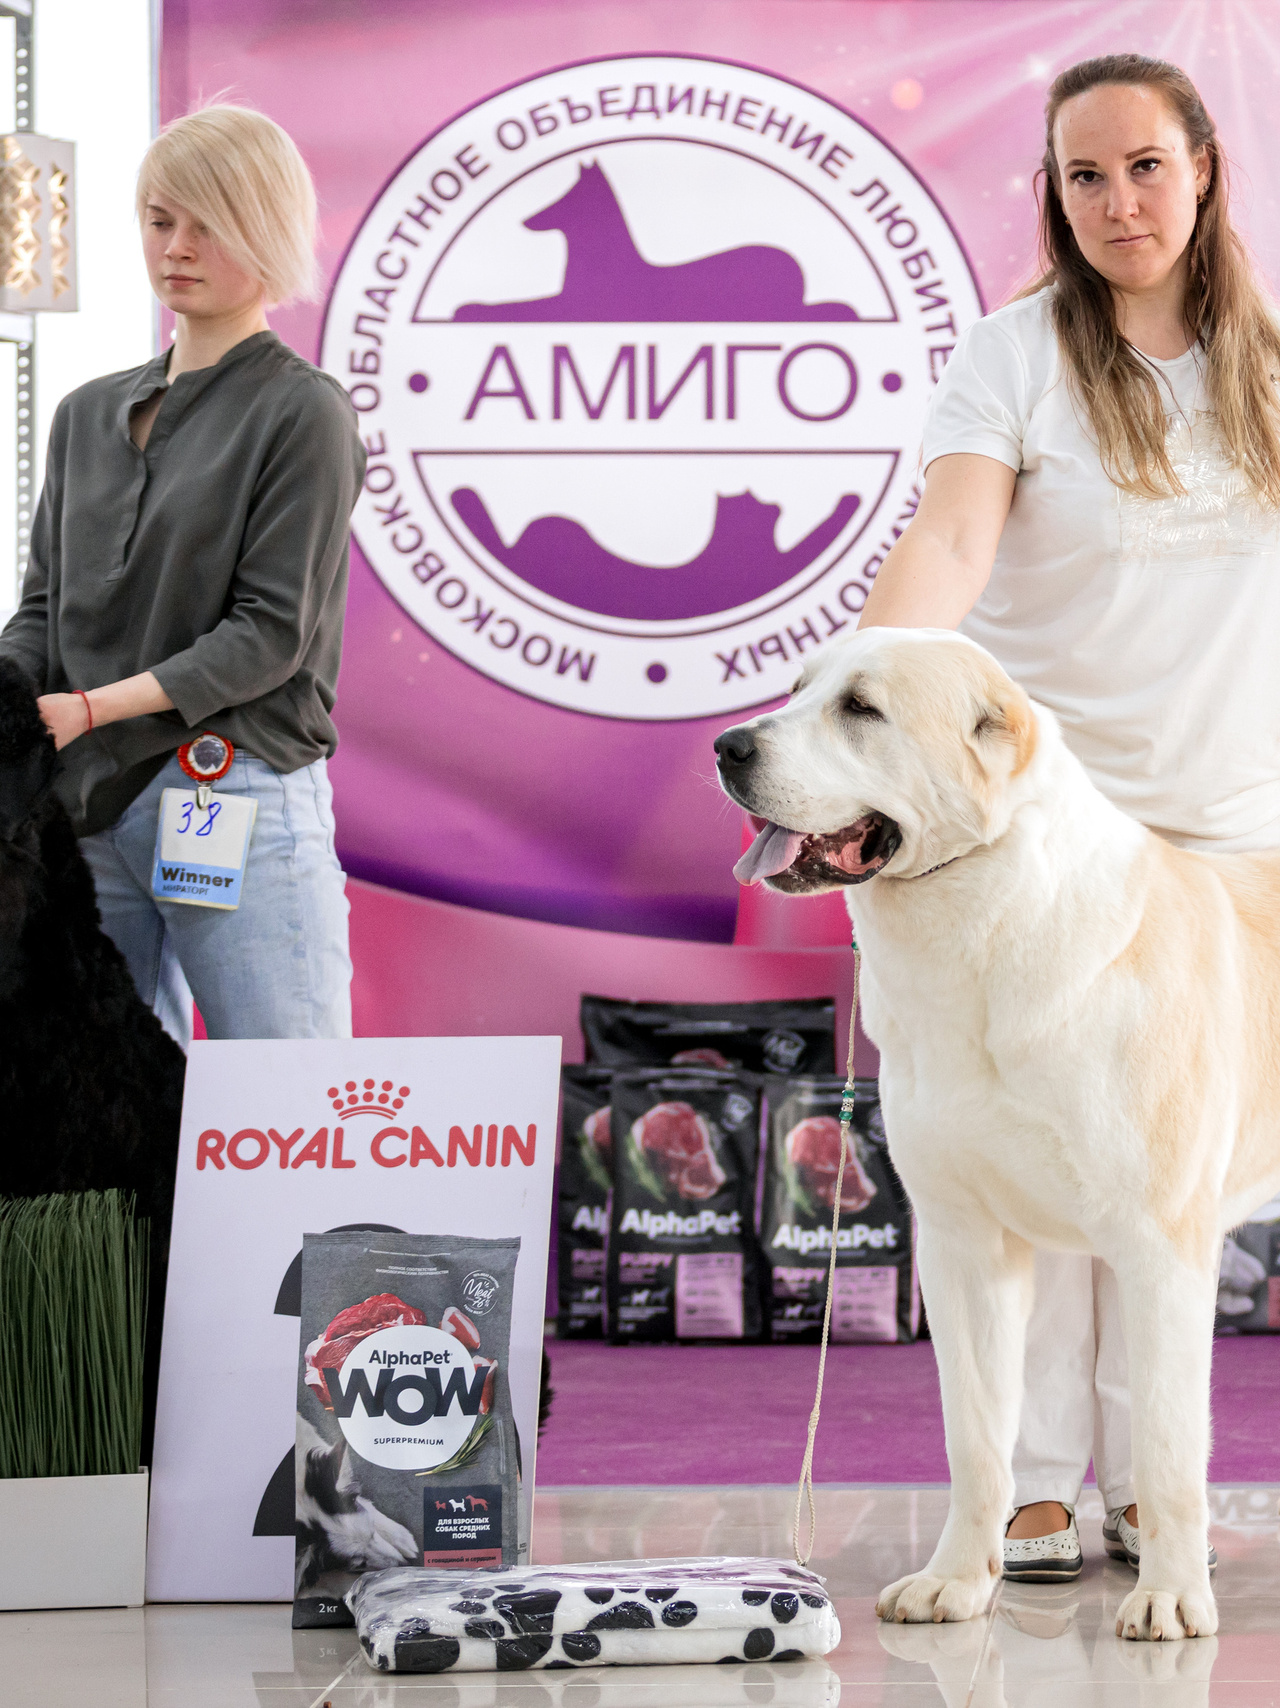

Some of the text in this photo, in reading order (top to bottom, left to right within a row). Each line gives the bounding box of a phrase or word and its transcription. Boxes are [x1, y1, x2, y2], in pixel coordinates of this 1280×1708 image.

[350, 145, 490, 413] ОБЛАСТНОЕ
[495, 83, 855, 177] ОБЪЕДИНЕНИЕ
[850, 178, 958, 385] ЛЮБИТЕ
[463, 342, 859, 422] АМИГО
[177, 802, 222, 836] 38
[161, 867, 234, 888] Winner
[162, 884, 210, 895] МИРАТОРГ
[196, 1123, 537, 1171] ROYAL CANIN
[619, 1207, 742, 1240] AlphaPet
[771, 1222, 899, 1256] AlphaPet
[463, 1278, 496, 1299] Meat
[369, 1350, 450, 1367] AlphaPet
[322, 1366, 490, 1426] WOW
[374, 1437, 444, 1446] SUPERPREMIUM
[459, 1524, 490, 1532] СРЕДНИХ
